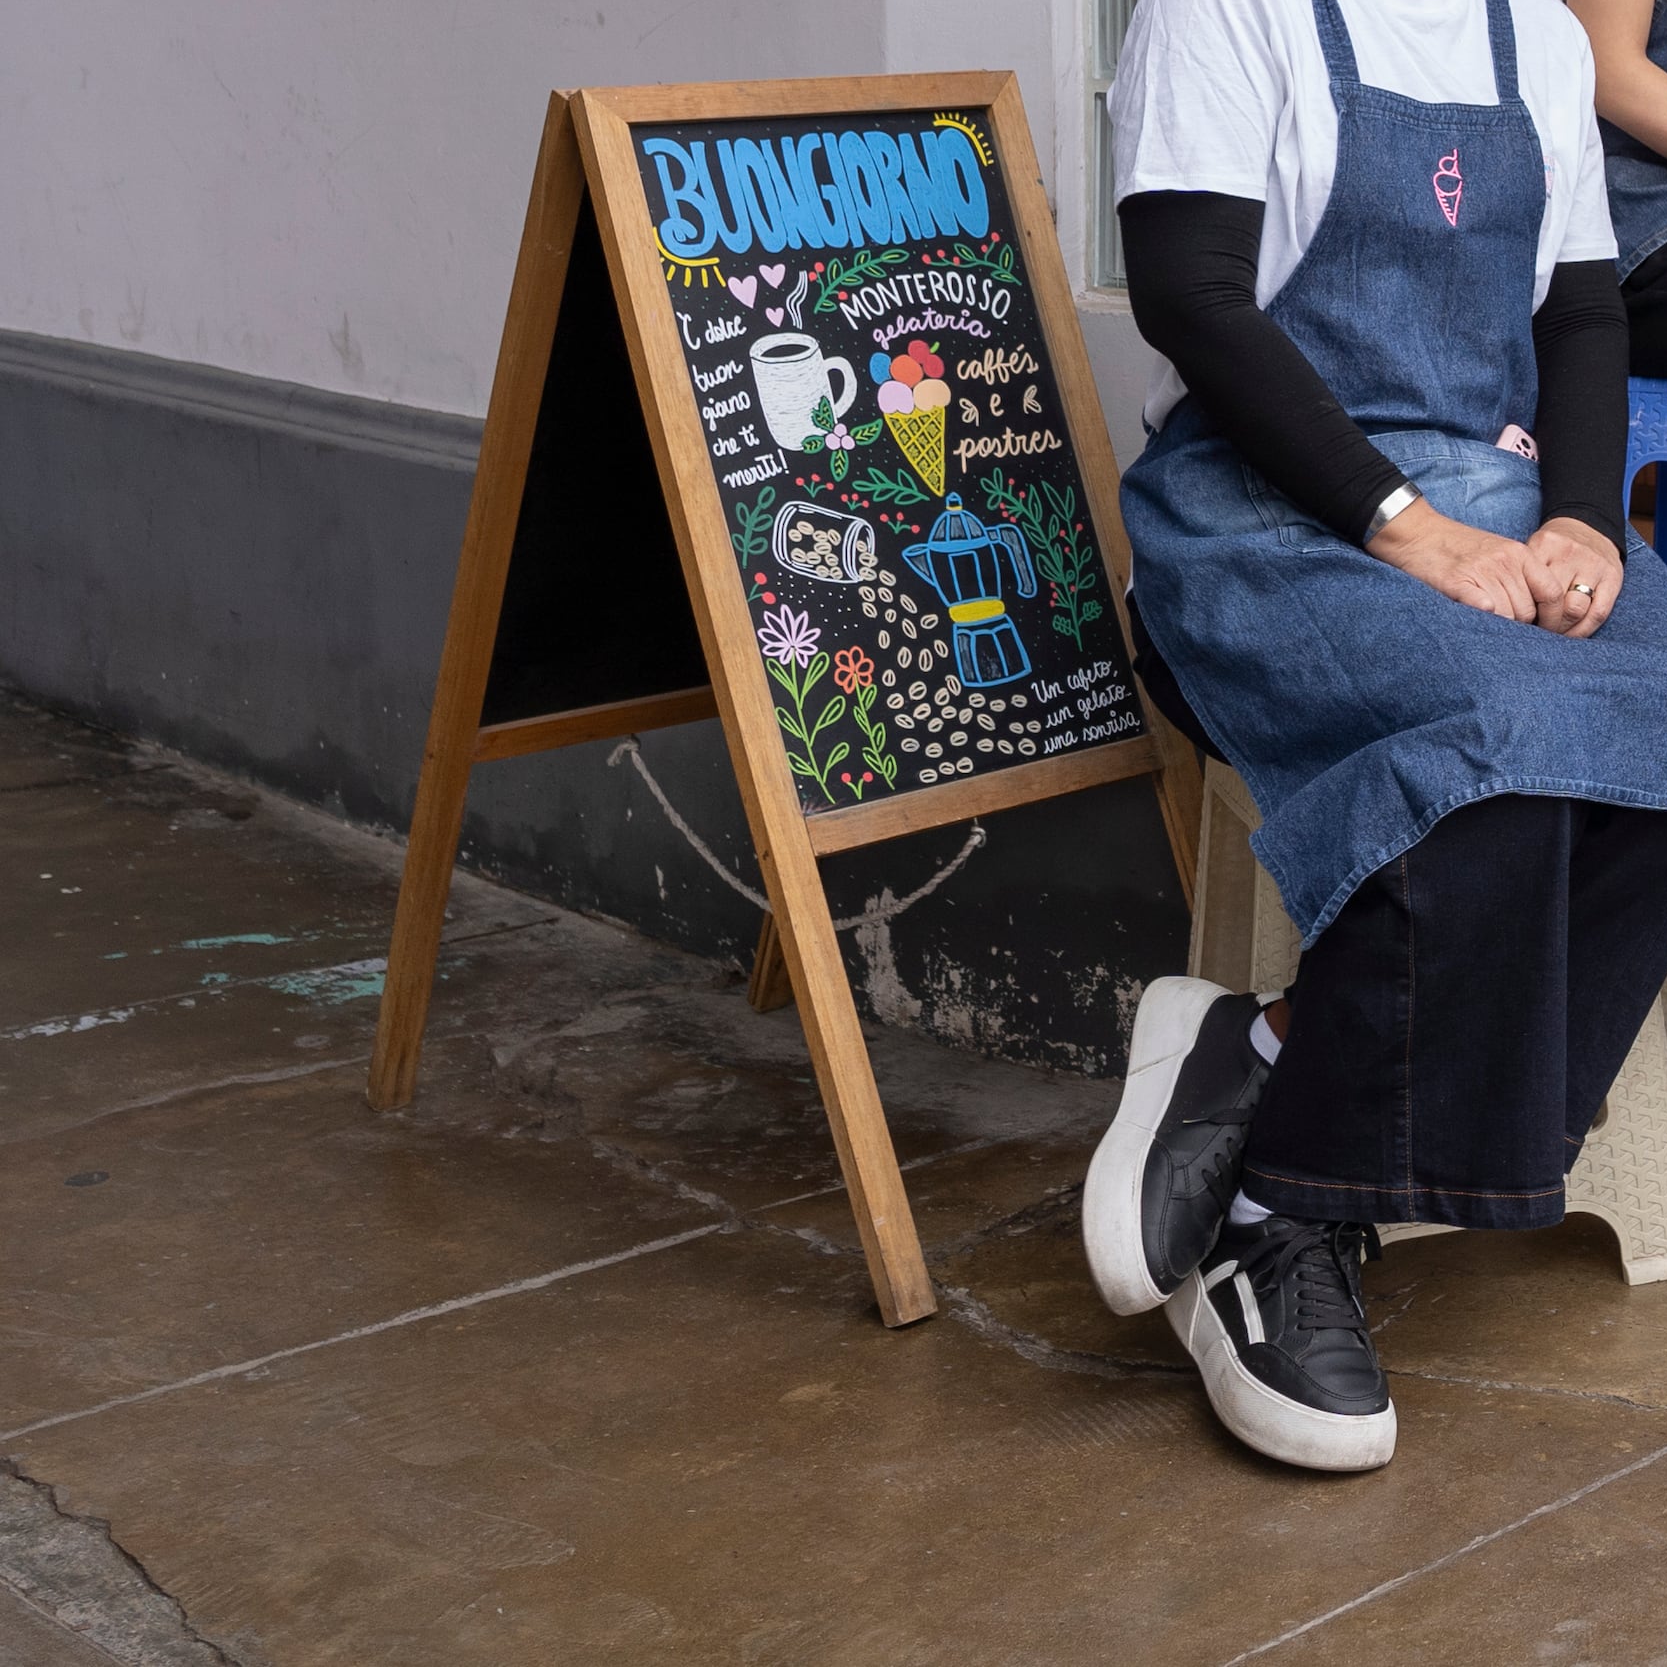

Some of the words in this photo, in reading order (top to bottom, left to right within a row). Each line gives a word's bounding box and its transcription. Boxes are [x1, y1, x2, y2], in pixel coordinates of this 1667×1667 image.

[643, 128, 989, 257] BUONGIORNO
[705, 315, 748, 345] dolce
[873, 307, 992, 351] gelateria
[692, 360, 744, 393] buon
[990, 393, 1004, 416] e
[713, 437, 741, 457] che
[738, 424, 760, 447] ti
[953, 426, 1062, 473] postres
[1031, 680, 1065, 703] Un
[1046, 706, 1075, 728] un
[1044, 731, 1079, 754] una
